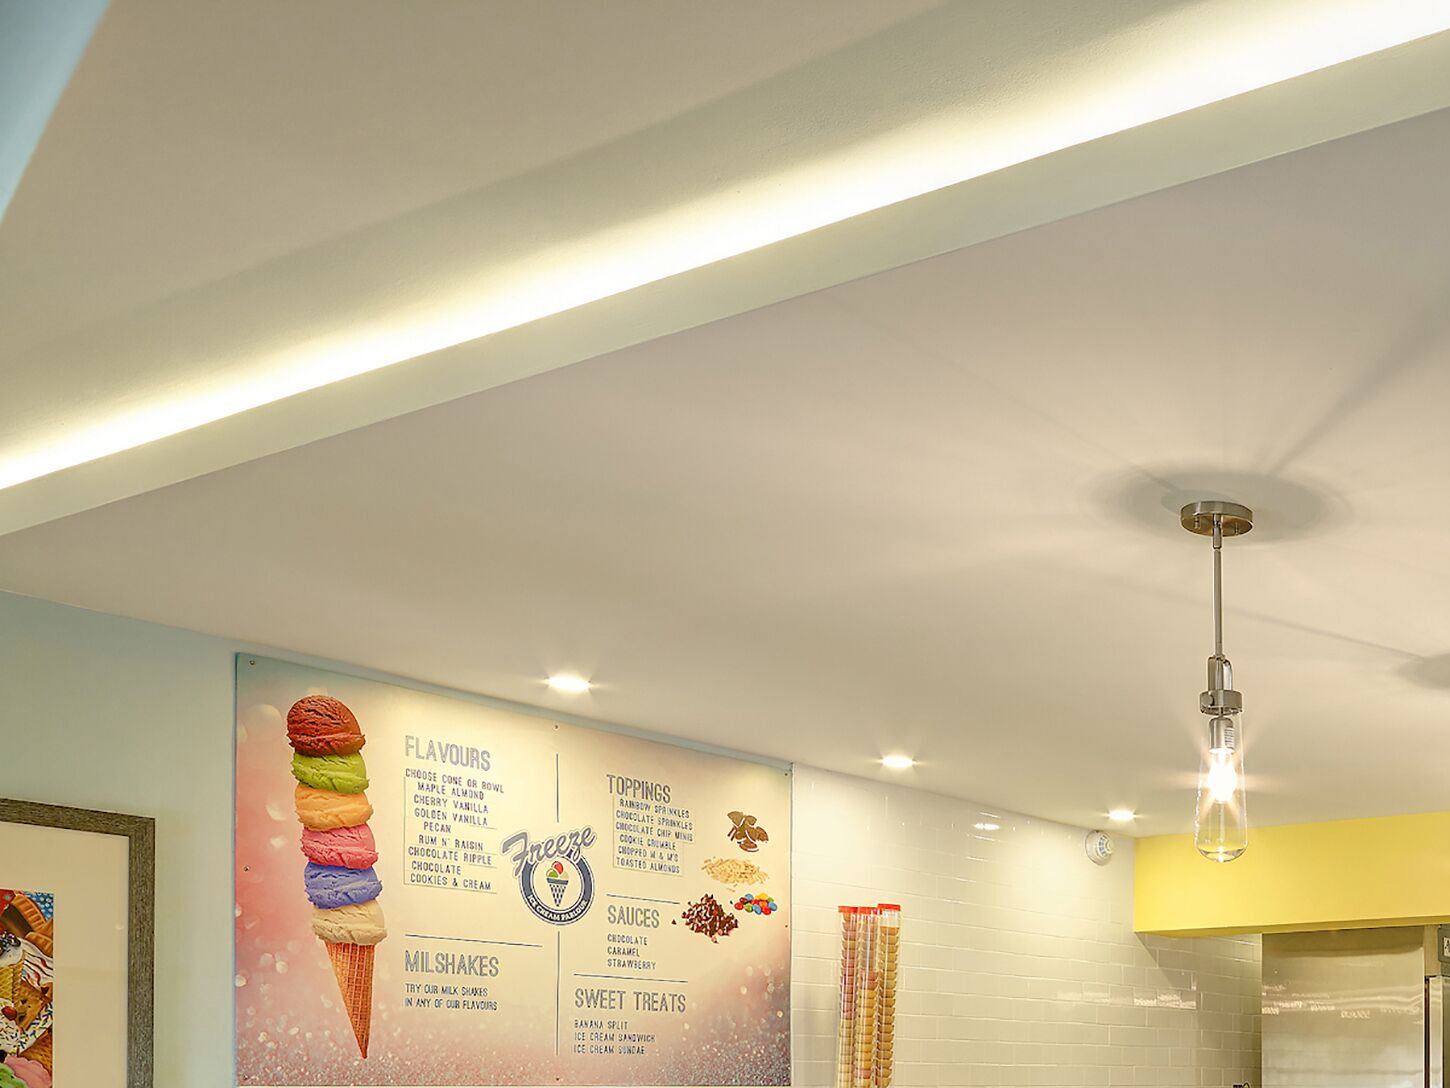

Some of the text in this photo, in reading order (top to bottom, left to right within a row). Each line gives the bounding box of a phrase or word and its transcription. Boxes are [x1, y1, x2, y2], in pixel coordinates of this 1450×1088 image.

[405, 735, 491, 771] FLAVOURS
[405, 769, 504, 793] CHOOSE CONE OR BOWL
[607, 775, 671, 803] TOPPINGS
[418, 782, 484, 800] MAPLE ALMOND
[414, 795, 488, 813] CHERRY VANILLA
[620, 799, 689, 818] RAINBOW SPRINKLES
[414, 808, 487, 825] GOLDEN VANILLA
[616, 811, 693, 830] CHOCOLATE SPRINKLES
[424, 822, 451, 833] PECAN
[616, 822, 653, 836] CHOCOLATE
[419, 835, 437, 845] RUM
[455, 839, 483, 851] RAISIN
[620, 835, 644, 846] COOKIE
[408, 846, 492, 865] CHOCOLATE RIPPLE
[502, 827, 596, 877] Freeze
[618, 846, 647, 857] CHOPPED
[412, 861, 461, 875] CHOCOLATE
[616, 858, 680, 873] TOASTED ALMONDS
[411, 873, 491, 890] COOKIES & CREAM
[527, 895, 587, 921] ICE CREAM PARLOUR
[608, 905, 659, 928] SAUCES
[608, 934, 647, 945] CHOCOLATE
[608, 946, 640, 957] CARAMEL
[405, 950, 499, 977] MILSHAKES
[607, 959, 656, 970] STRAWBERRY
[405, 983, 487, 997] TRY OUR MILK SHAKES
[405, 998, 497, 1011] IN ANY OF OUR FLAVOURS
[575, 988, 686, 1012] SWEET TREATS
[574, 1020, 628, 1030] BANANA SPLIT
[574, 1033, 585, 1041] ICE
[619, 1034, 655, 1042] SANDWICH
[574, 1045, 645, 1054] ICE CREAM SUNDAE
